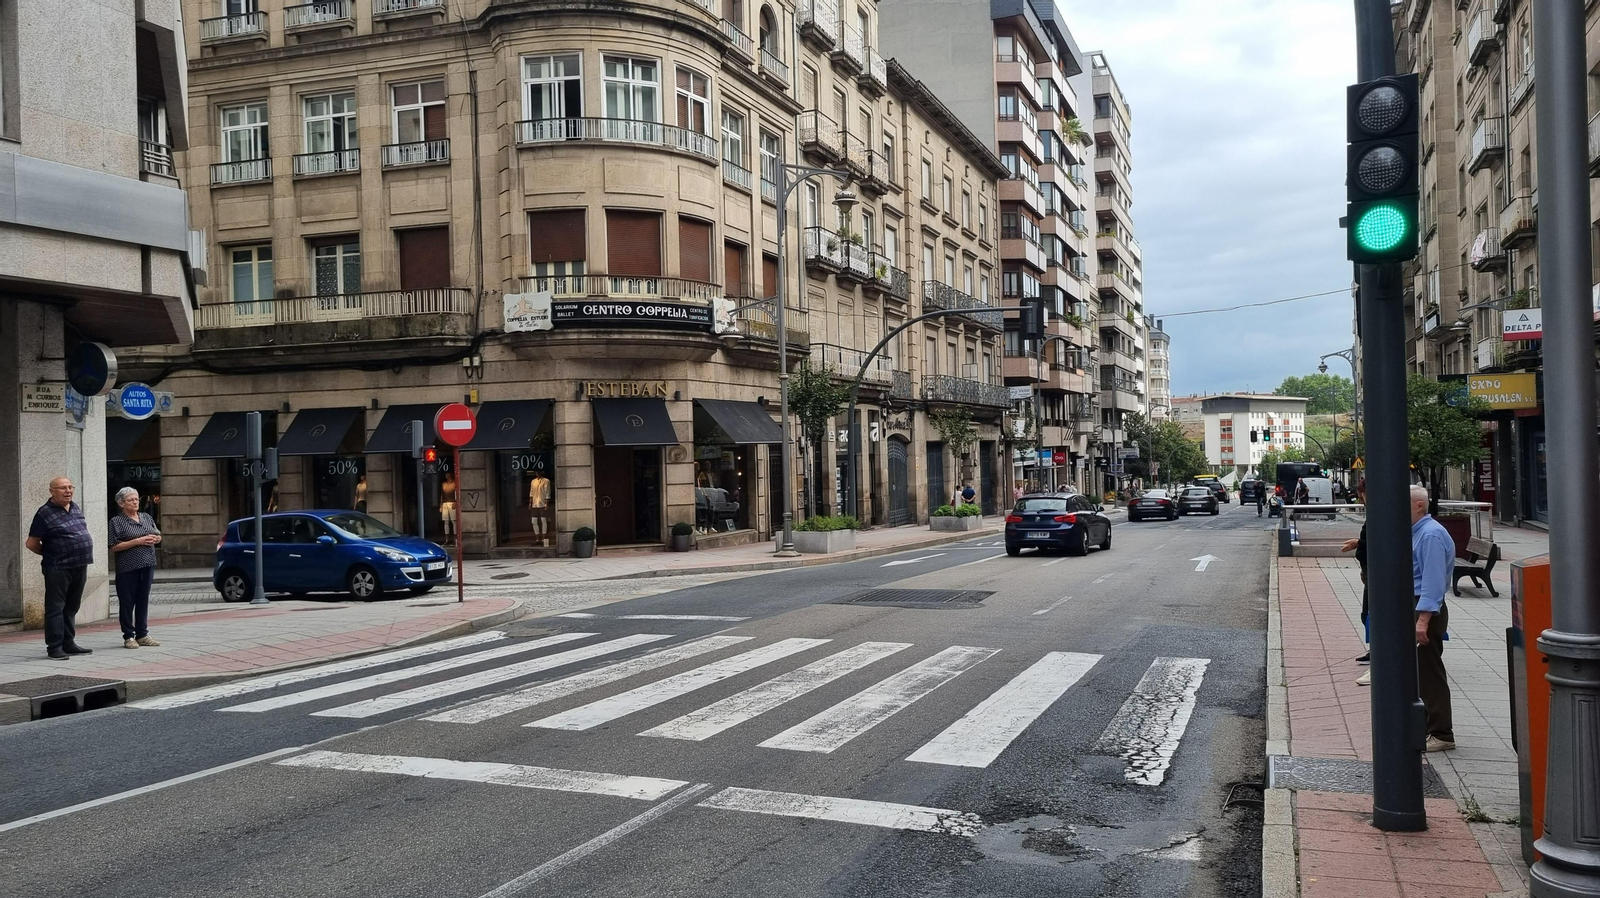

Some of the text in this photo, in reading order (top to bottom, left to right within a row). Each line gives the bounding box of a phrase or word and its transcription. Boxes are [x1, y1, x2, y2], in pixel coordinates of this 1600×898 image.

[583, 305, 688, 319] CENTRO COPPELIA
[1504, 324, 1532, 332] DELTA
[587, 382, 668, 396] ESTEBAN
[1470, 379, 1501, 390] EXPO
[128, 390, 147, 398] AUTOS
[1474, 393, 1522, 404] RUSALEN
[28, 401, 60, 409] ENRIQUEZ
[123, 398, 153, 408] SANTA RITA
[328, 460, 358, 475] 50%
[511, 454, 544, 470] 50%
[129, 466, 153, 478] 50%
